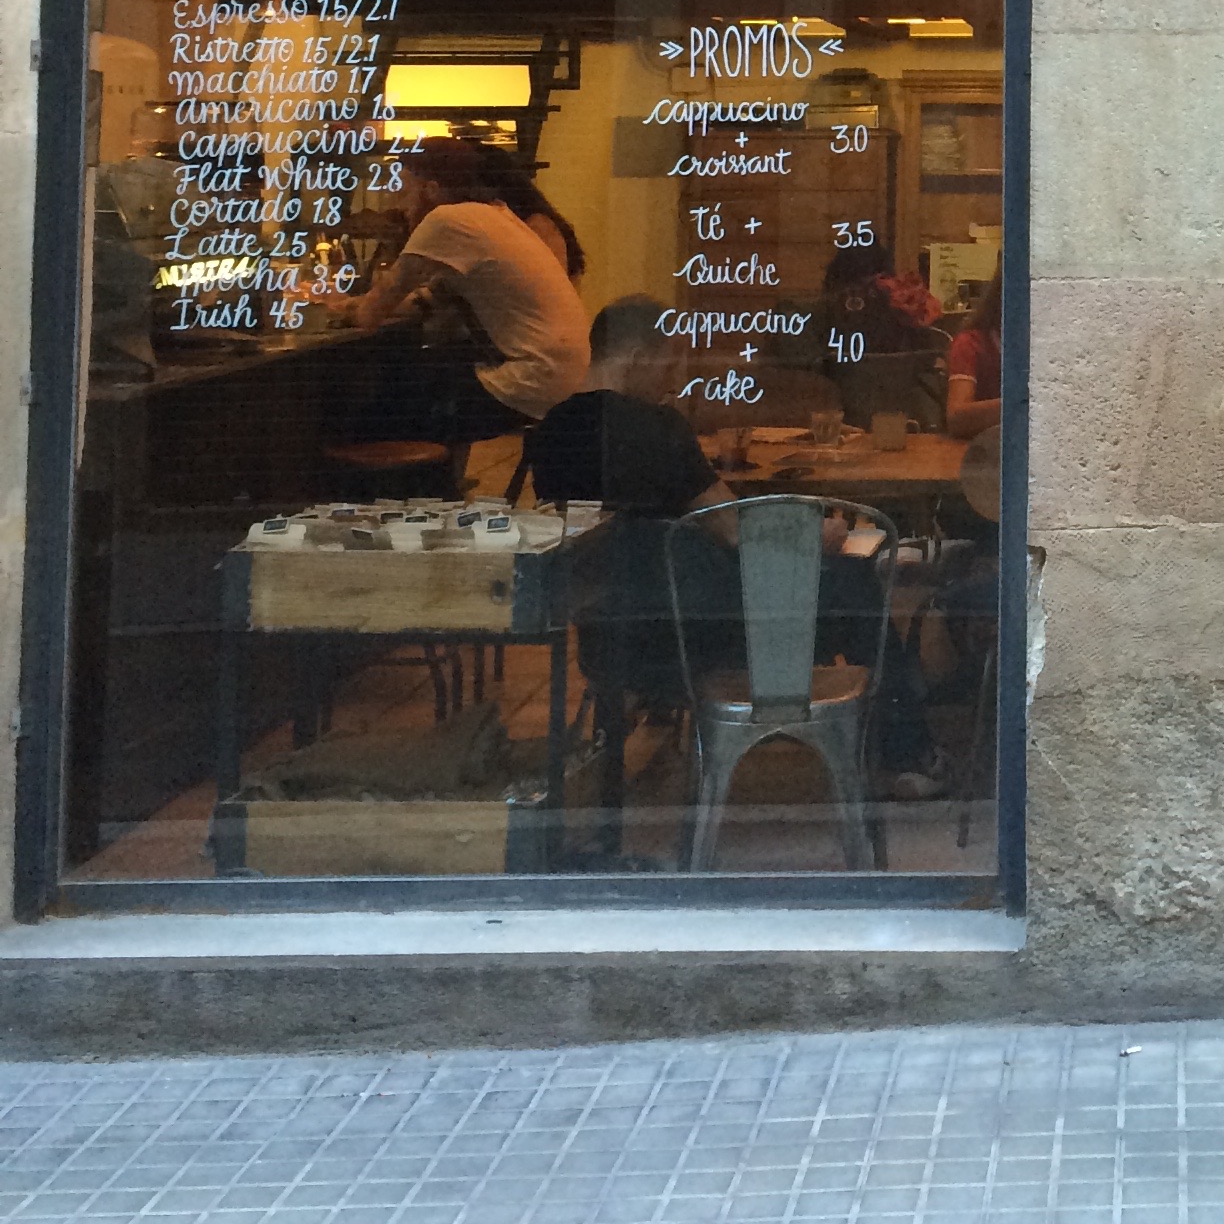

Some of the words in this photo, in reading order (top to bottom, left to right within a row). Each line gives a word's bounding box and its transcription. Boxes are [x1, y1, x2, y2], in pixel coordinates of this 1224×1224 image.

[169, 33, 295, 64] Ristretto
[689, 22, 813, 78] PROMOS
[178, 124, 377, 168] Cappuccino
[829, 124, 868, 154] 3.0
[173, 162, 253, 195] Flat
[367, 162, 404, 192] 2.8
[667, 148, 792, 176] croissant
[170, 193, 302, 228] Cortado
[689, 203, 725, 240] té
[831, 220, 875, 248] 3.5
[164, 227, 263, 260] Latte
[273, 231, 308, 257] 2.5
[312, 265, 354, 294] 3.0
[672, 253, 781, 286] Quiche
[169, 295, 258, 330] Irish
[828, 327, 865, 363] 4.0
